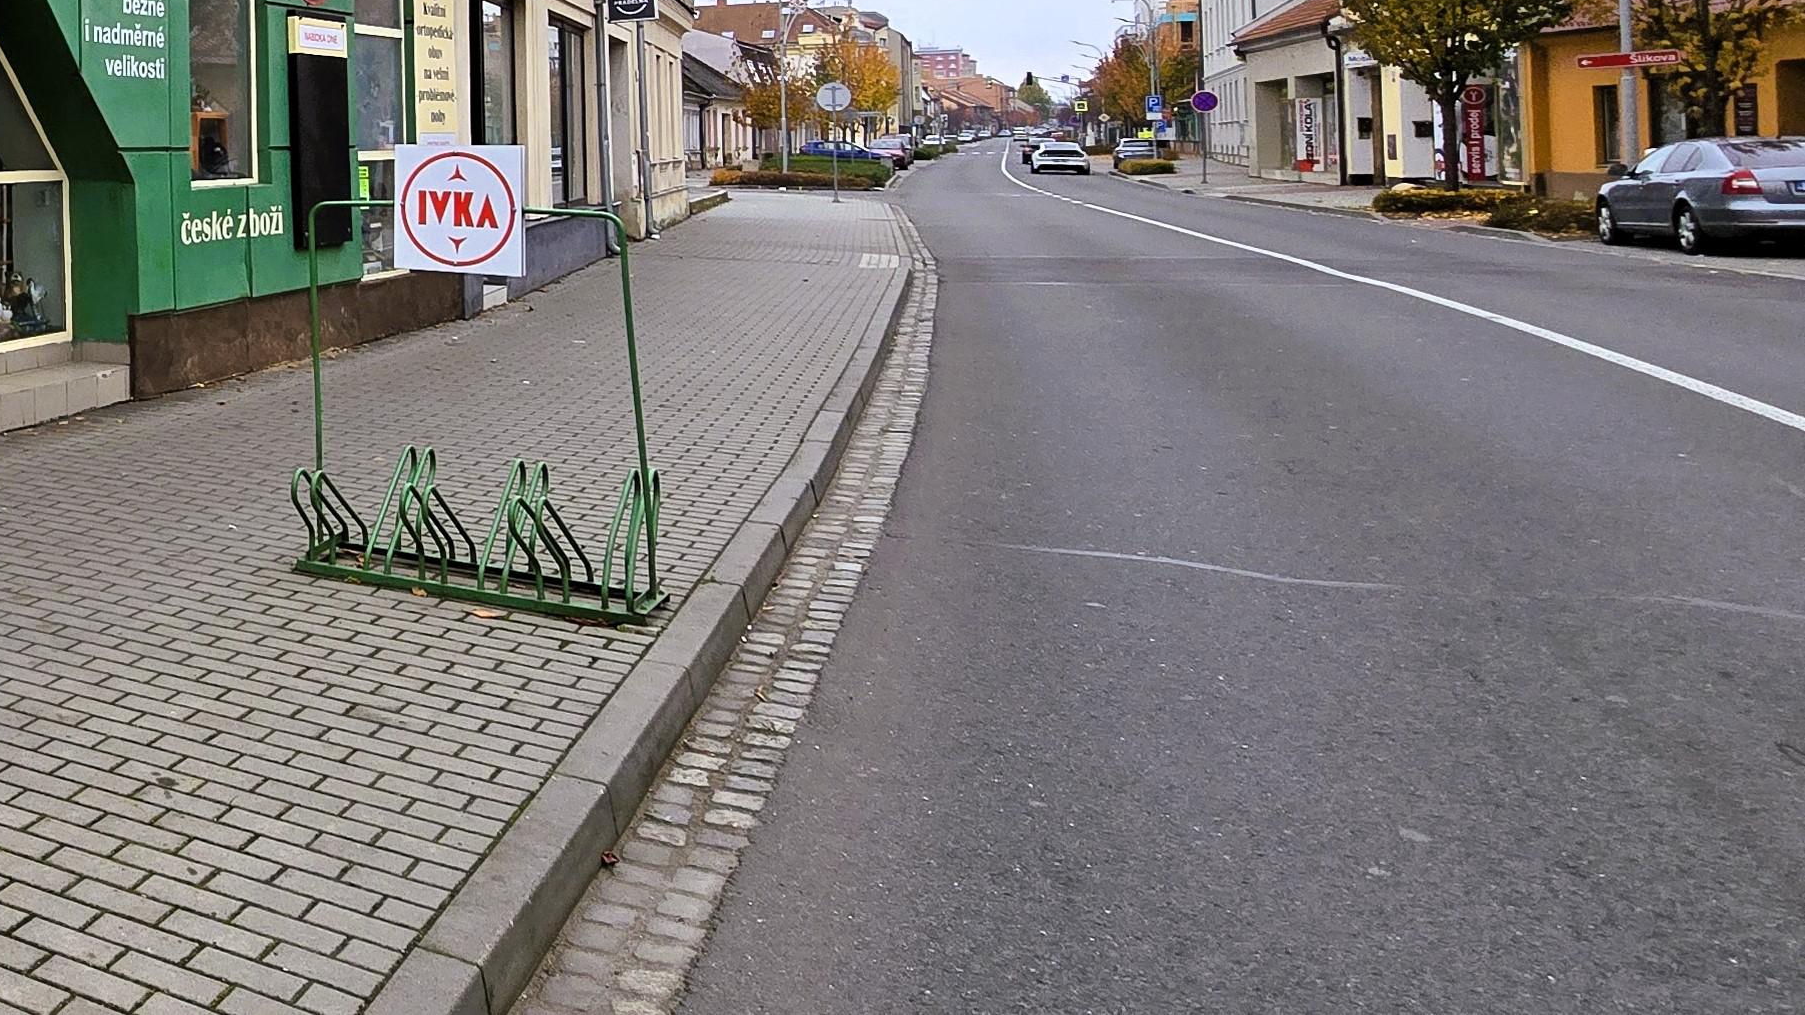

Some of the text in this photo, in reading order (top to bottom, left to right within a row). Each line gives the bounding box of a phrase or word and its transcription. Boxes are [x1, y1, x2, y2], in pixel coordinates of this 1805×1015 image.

[84, 18, 165, 48] i nadměrné
[105, 54, 165, 79] velikosti
[1467, 109, 1483, 139] prodej
[418, 189, 499, 229] IVKA
[180, 205, 284, 245] české zboží
